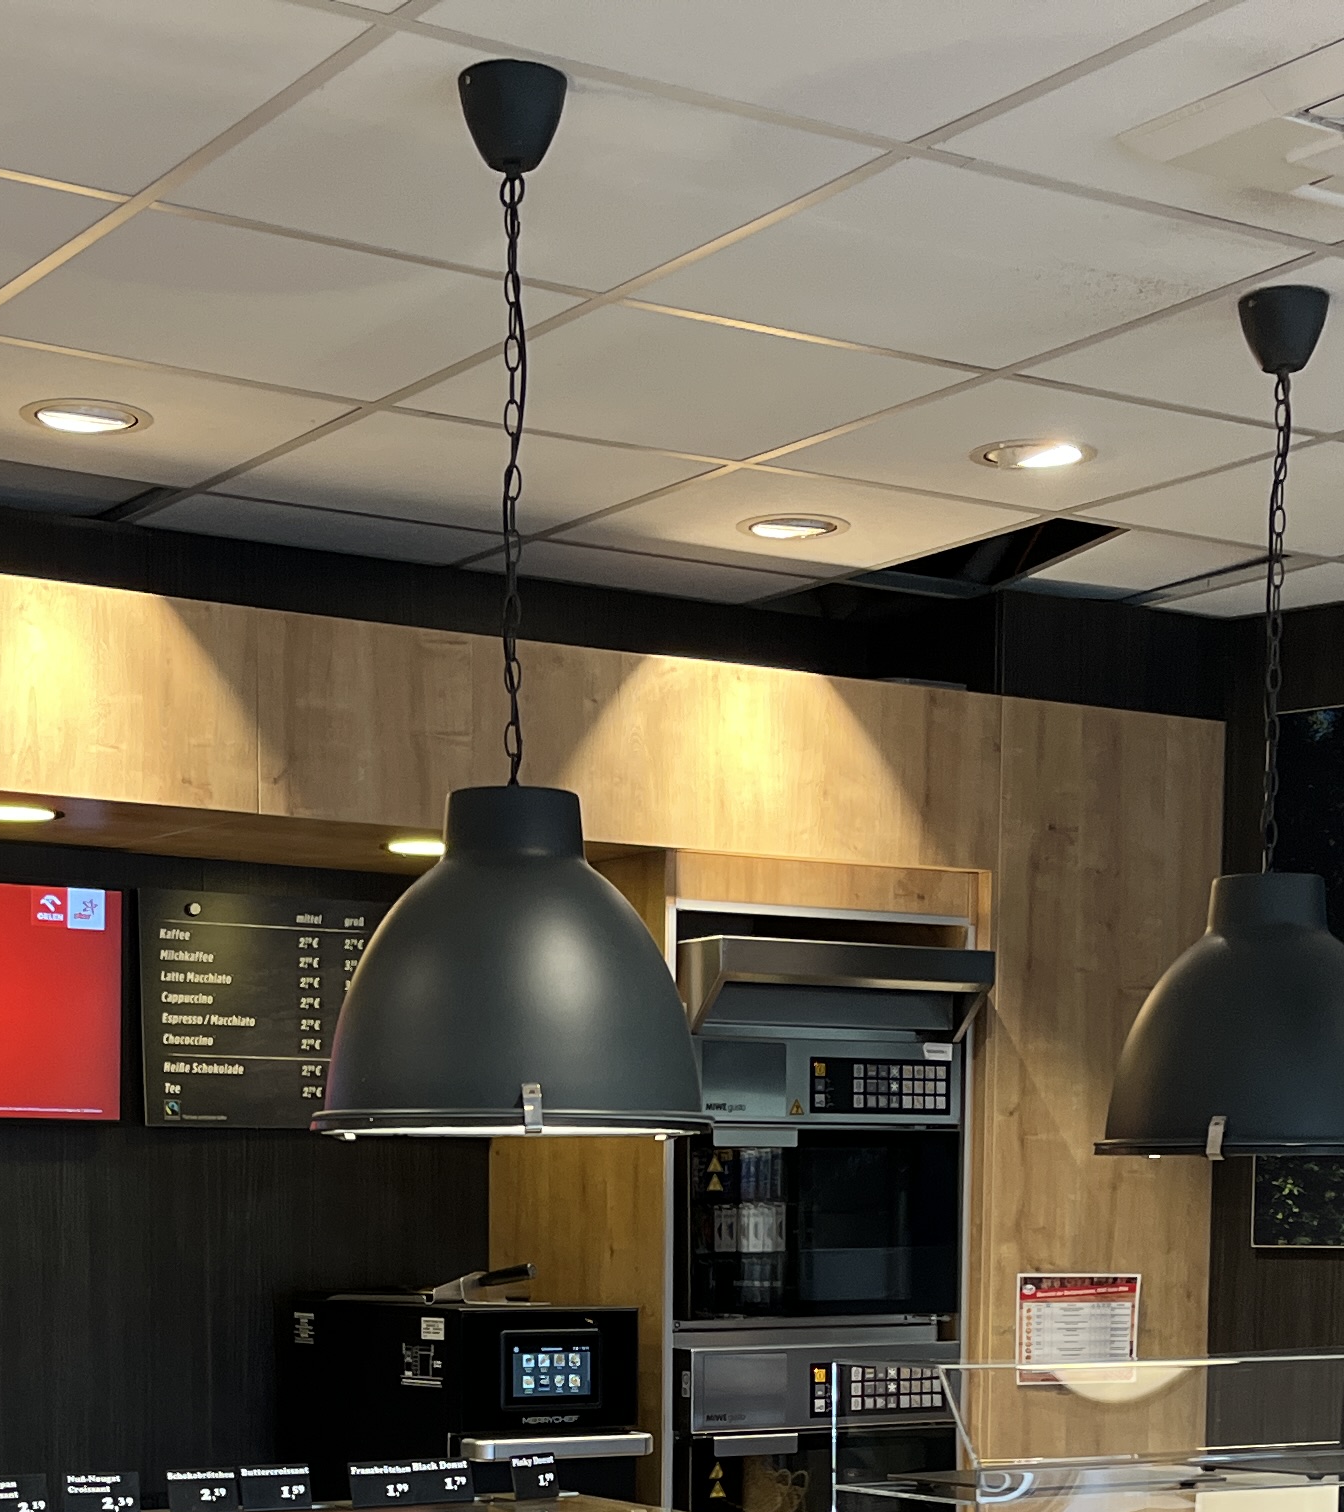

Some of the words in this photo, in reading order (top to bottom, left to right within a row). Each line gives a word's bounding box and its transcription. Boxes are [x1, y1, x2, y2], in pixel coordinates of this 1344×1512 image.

[296, 914, 323, 925] mittel
[159, 929, 191, 941] Kaffee
[160, 950, 214, 963] Milchkaffee
[161, 971, 185, 983] Latte
[186, 972, 232, 985] Macchiato
[161, 992, 214, 1005] Cappuccino
[162, 1013, 203, 1026] Espresso
[210, 1014, 256, 1027] Macchiato
[163, 1034, 214, 1047] Chococcino
[192, 1062, 244, 1075] Schokolade
[164, 1083, 181, 1094] Tee
[705, 1102, 727, 1112] MIWE
[522, 1415, 581, 1426] MERRYCHEF
[412, 1460, 438, 1472] Black
[439, 1459, 468, 1471] Donut
[533, 1455, 555, 1466] Donut
[167, 1470, 235, 1481] Schokobrötchen
[240, 1465, 309, 1477] Buttercroissant
[350, 1464, 411, 1476] Franzbrötchen
[67, 1484, 110, 1494] Croissant
[386, 1483, 409, 1498] 1,99
[444, 1476, 467, 1492] 1,79
[281, 1484, 305, 1500] 1,59
[102, 1496, 134, 1512] 2,39
